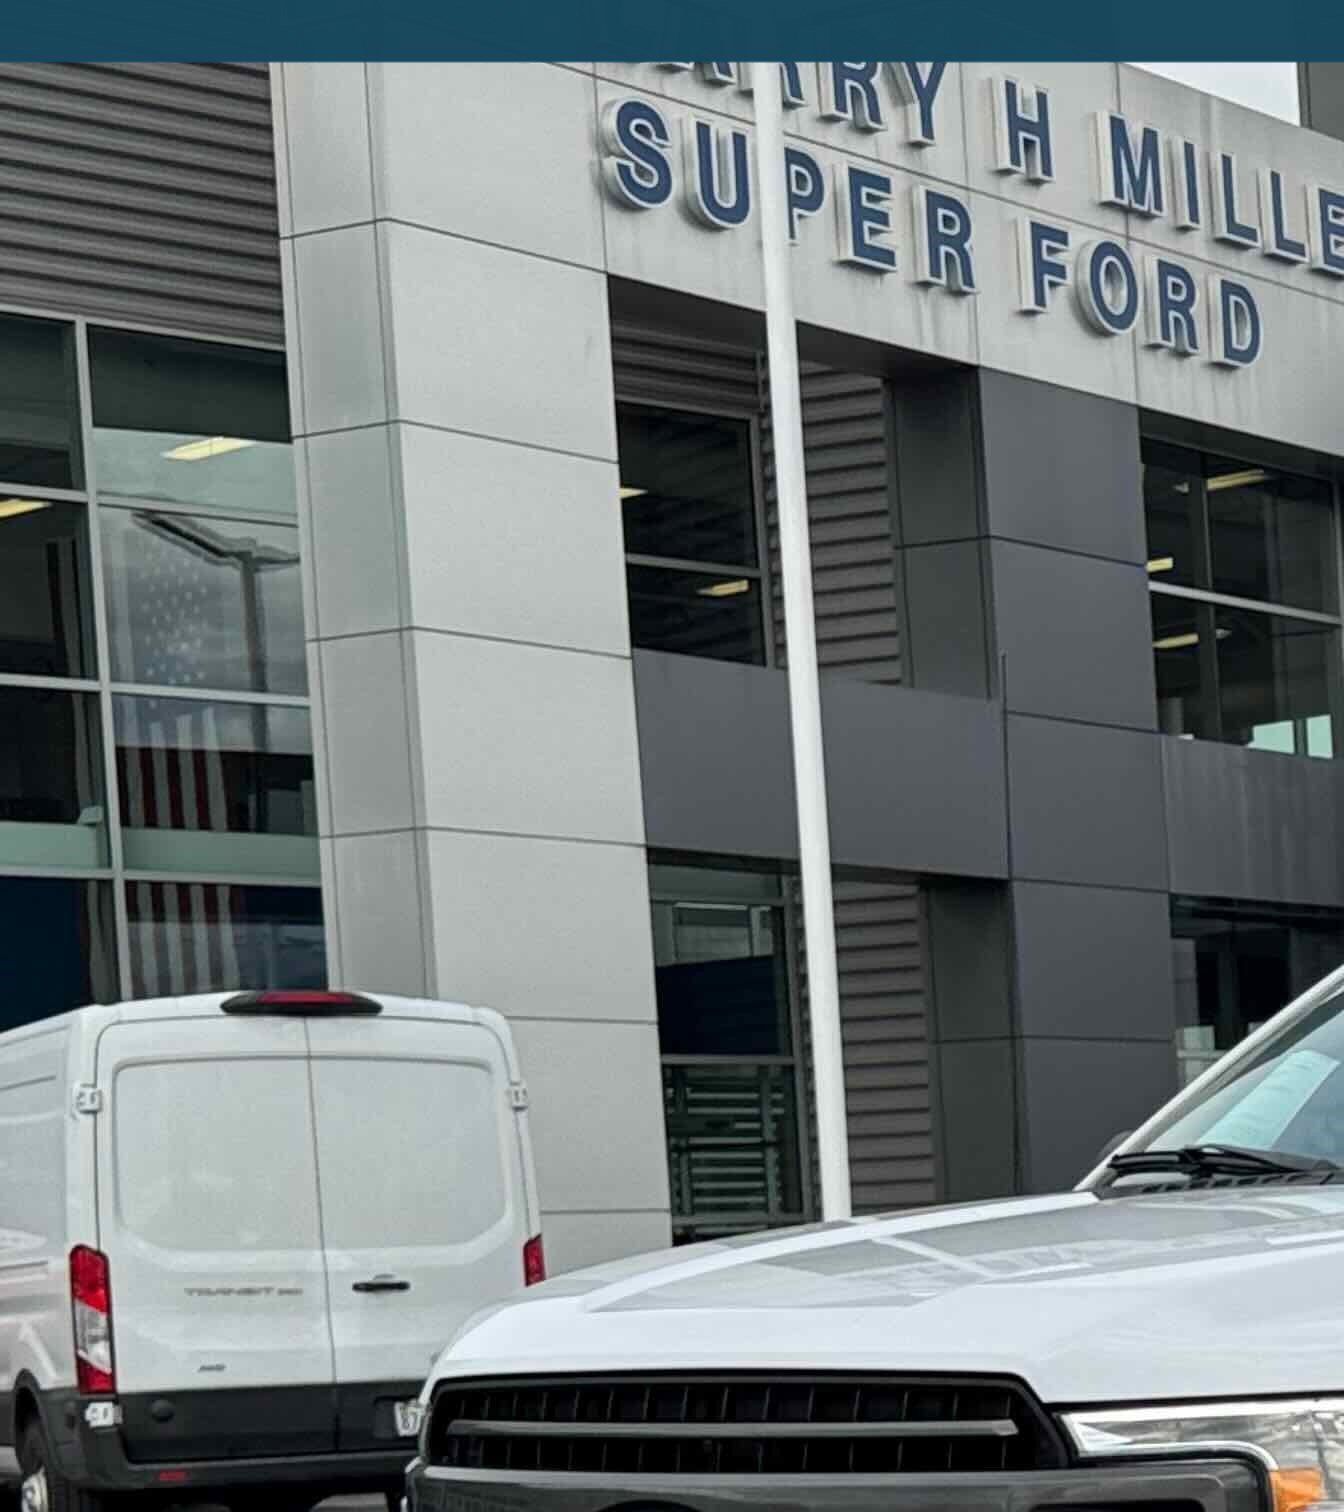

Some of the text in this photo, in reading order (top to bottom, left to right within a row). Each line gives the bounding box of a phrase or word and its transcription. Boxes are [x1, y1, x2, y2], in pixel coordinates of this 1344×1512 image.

[998, 78, 1055, 183] H
[606, 97, 1265, 370] SUPER FORD
